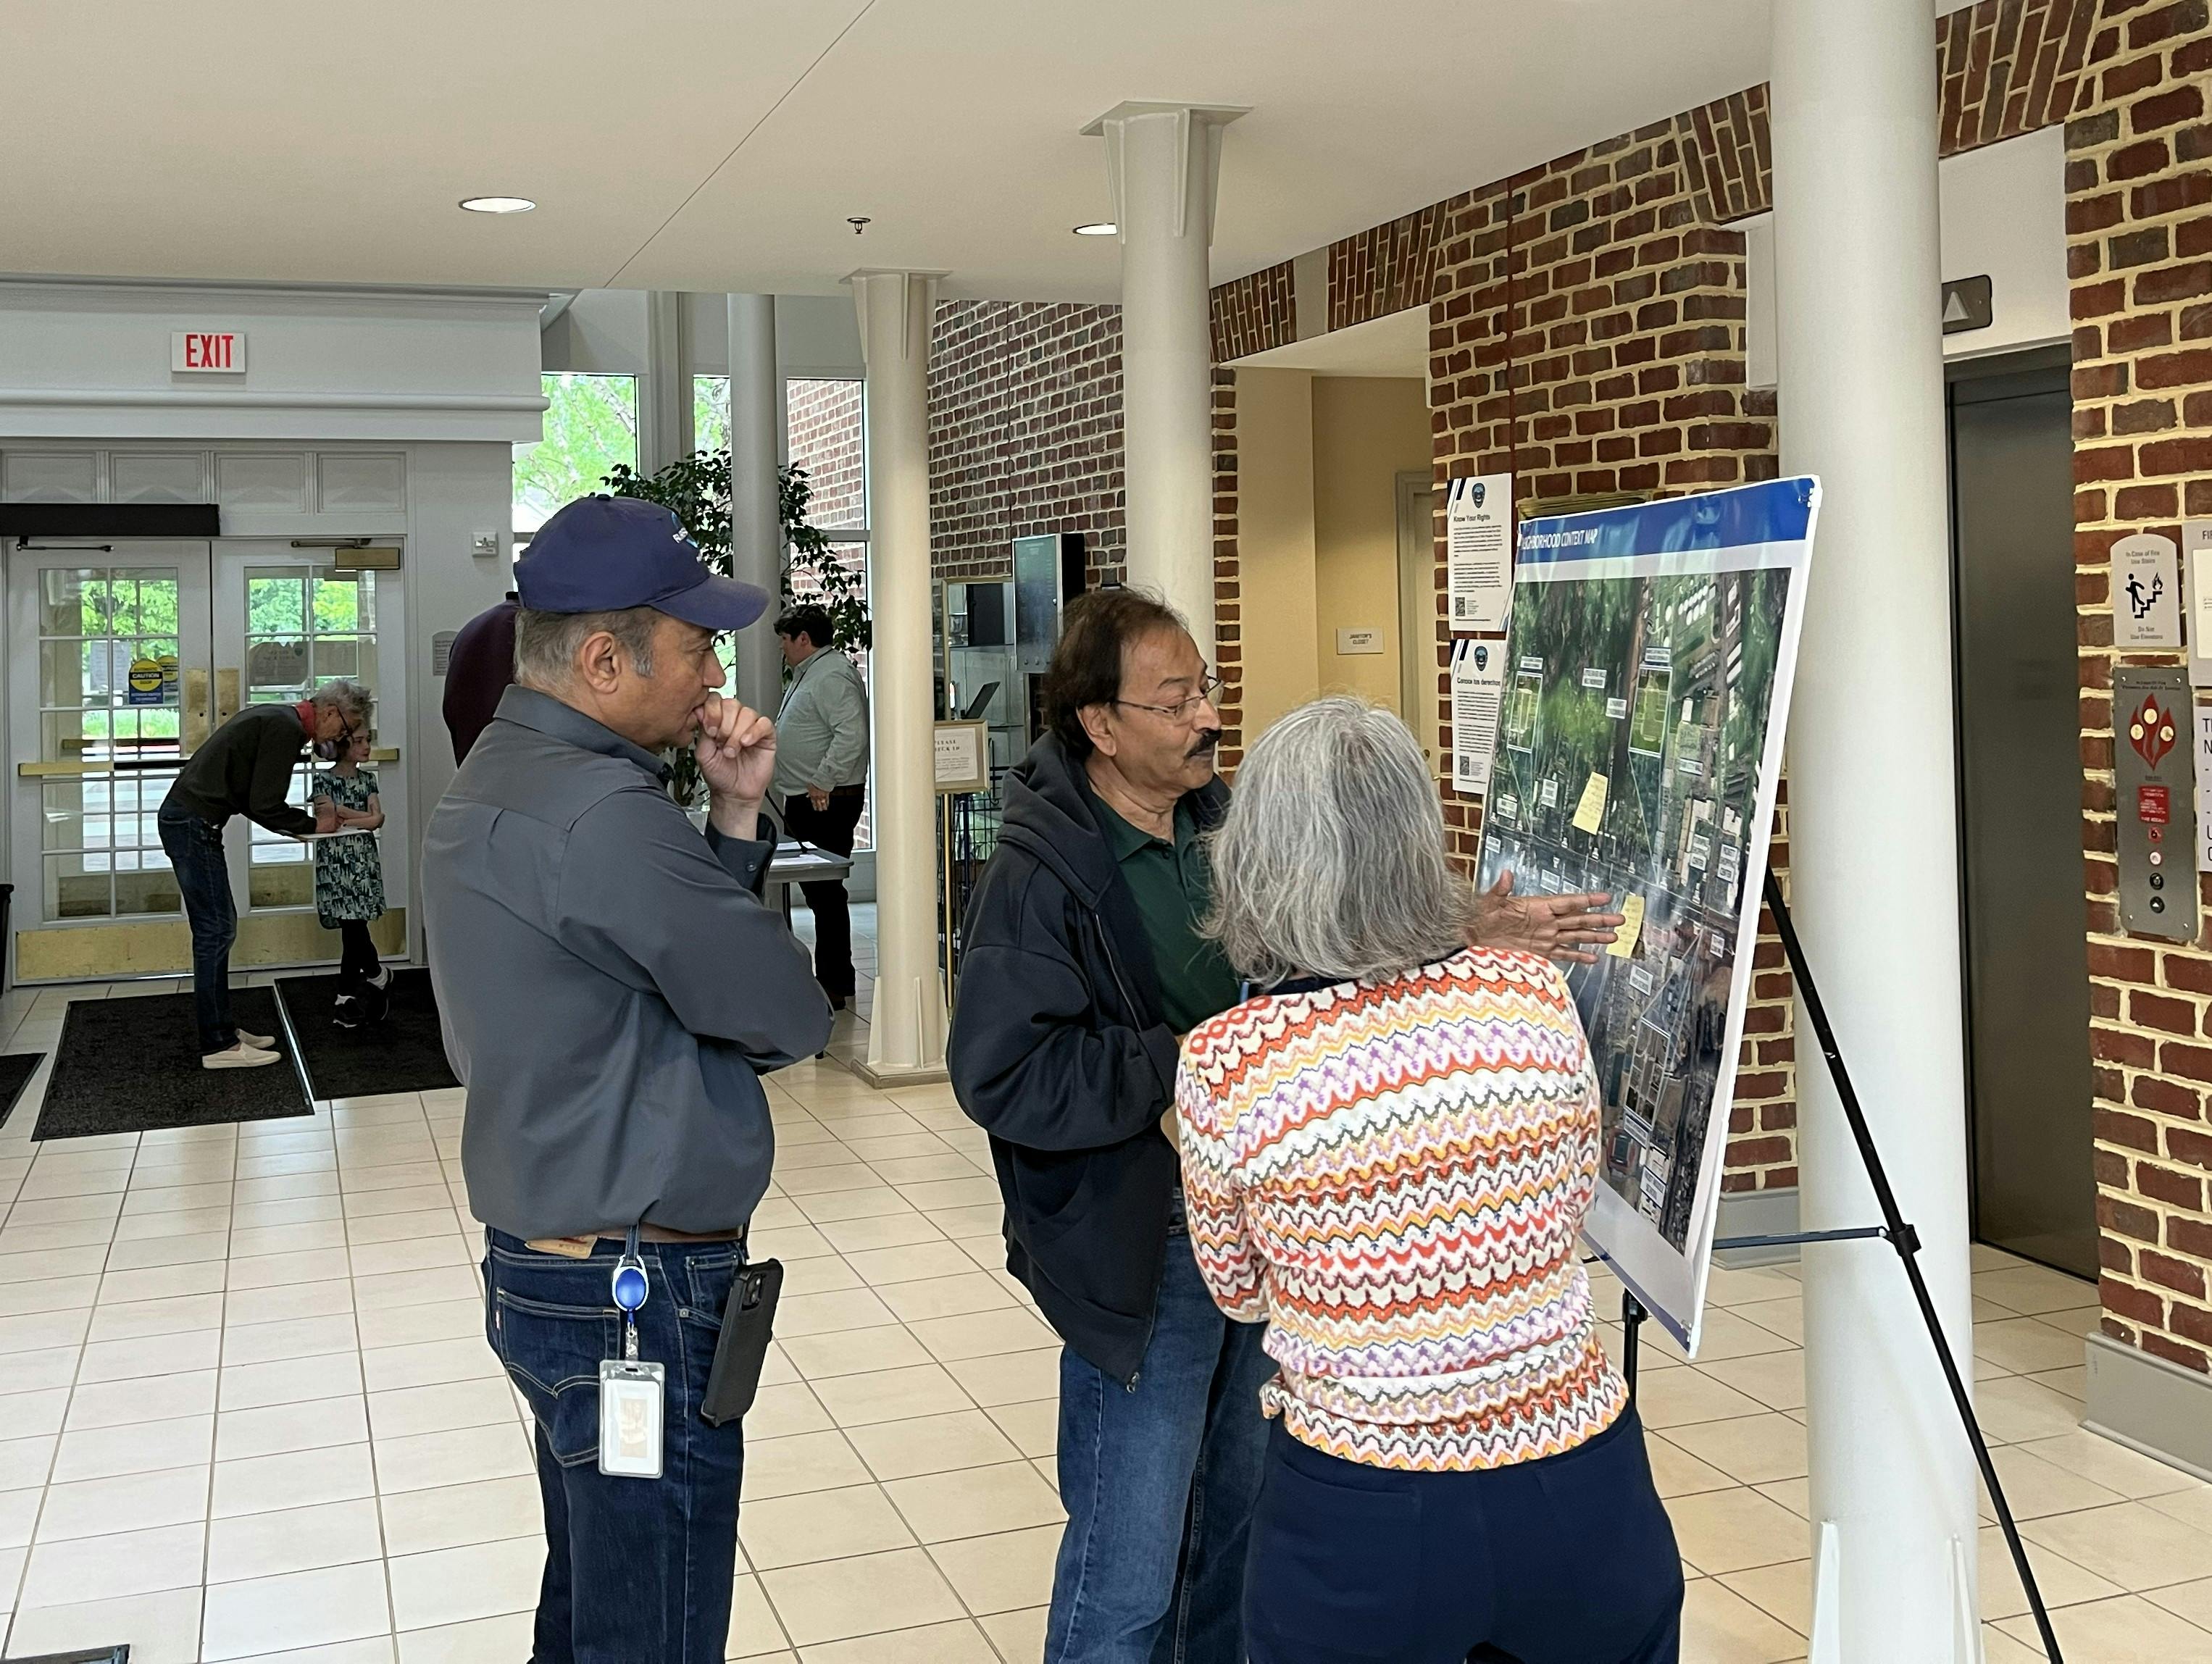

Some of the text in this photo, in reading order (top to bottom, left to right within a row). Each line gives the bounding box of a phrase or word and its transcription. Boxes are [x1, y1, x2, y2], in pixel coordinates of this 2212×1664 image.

[186, 335, 233, 367] EXIT
[1561, 530, 1585, 547] CONTEXT
[1585, 528, 1598, 544] MAP
[2203, 717, 2212, 733] T
